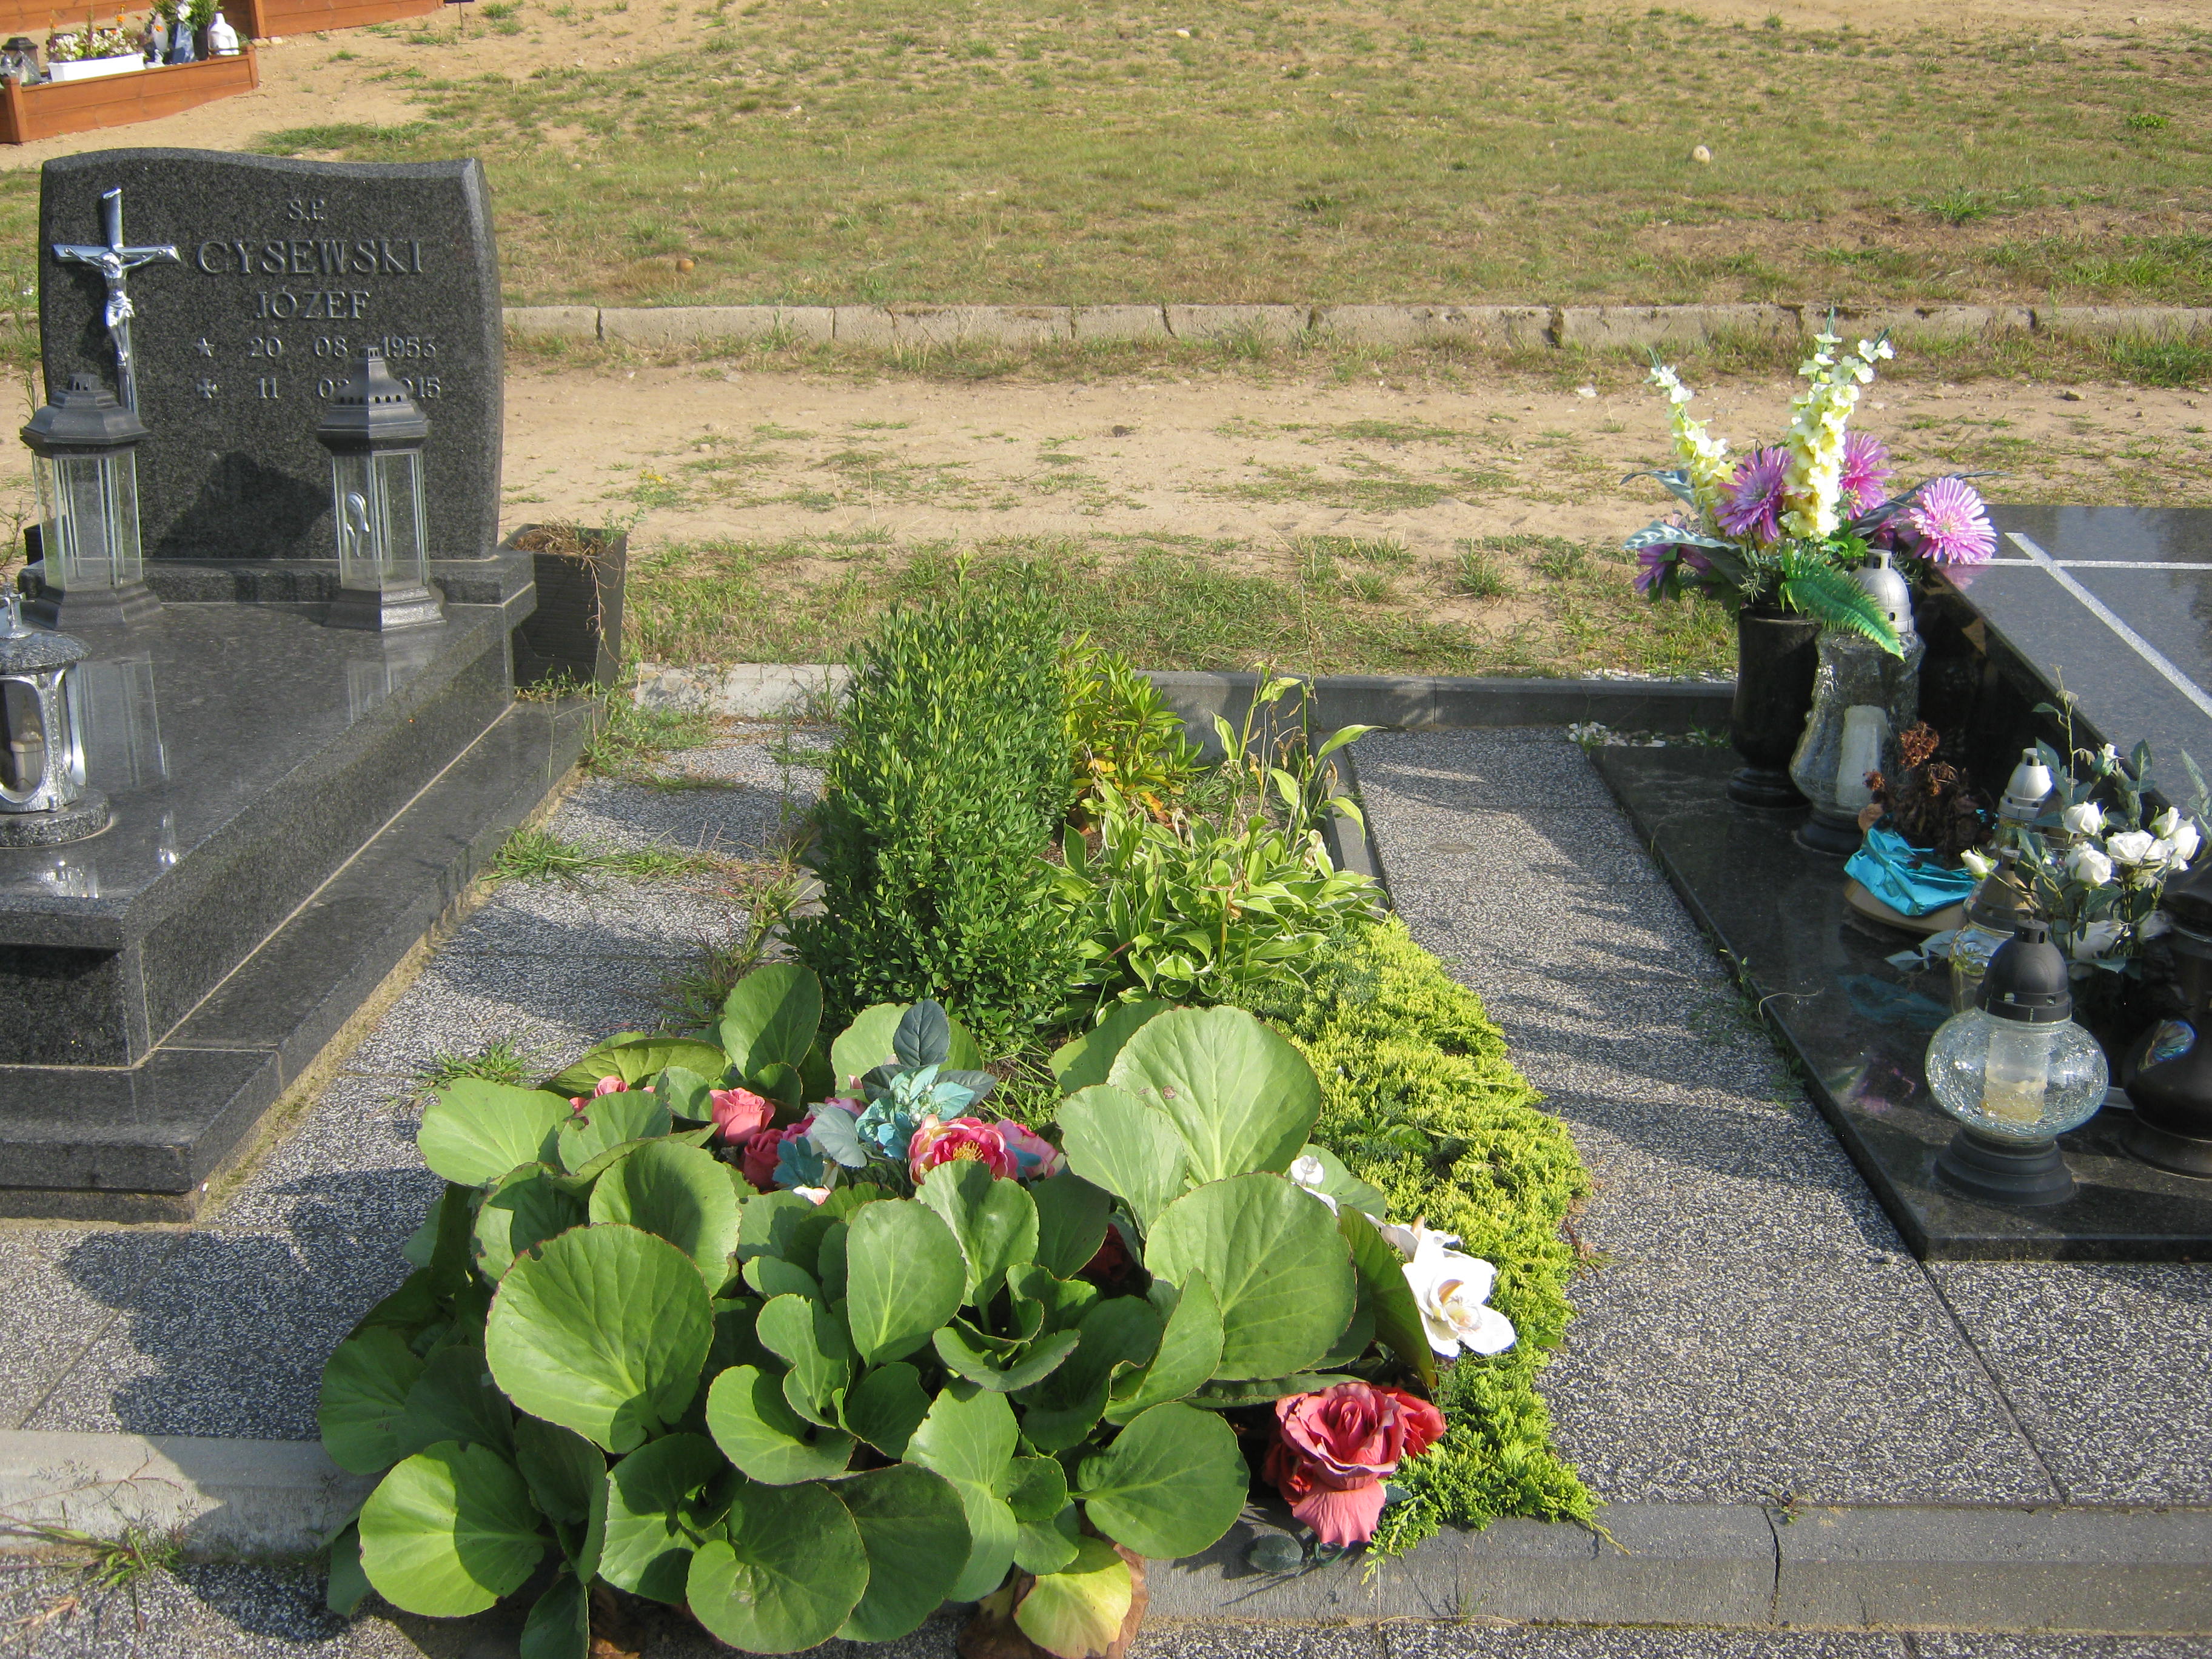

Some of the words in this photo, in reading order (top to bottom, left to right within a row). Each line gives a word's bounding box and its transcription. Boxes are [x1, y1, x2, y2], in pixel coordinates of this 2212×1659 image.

[197, 240, 424, 274] CYSEWSKI
[249, 336, 283, 357] 20
[313, 336, 349, 358] 08
[259, 377, 279, 399] 11
